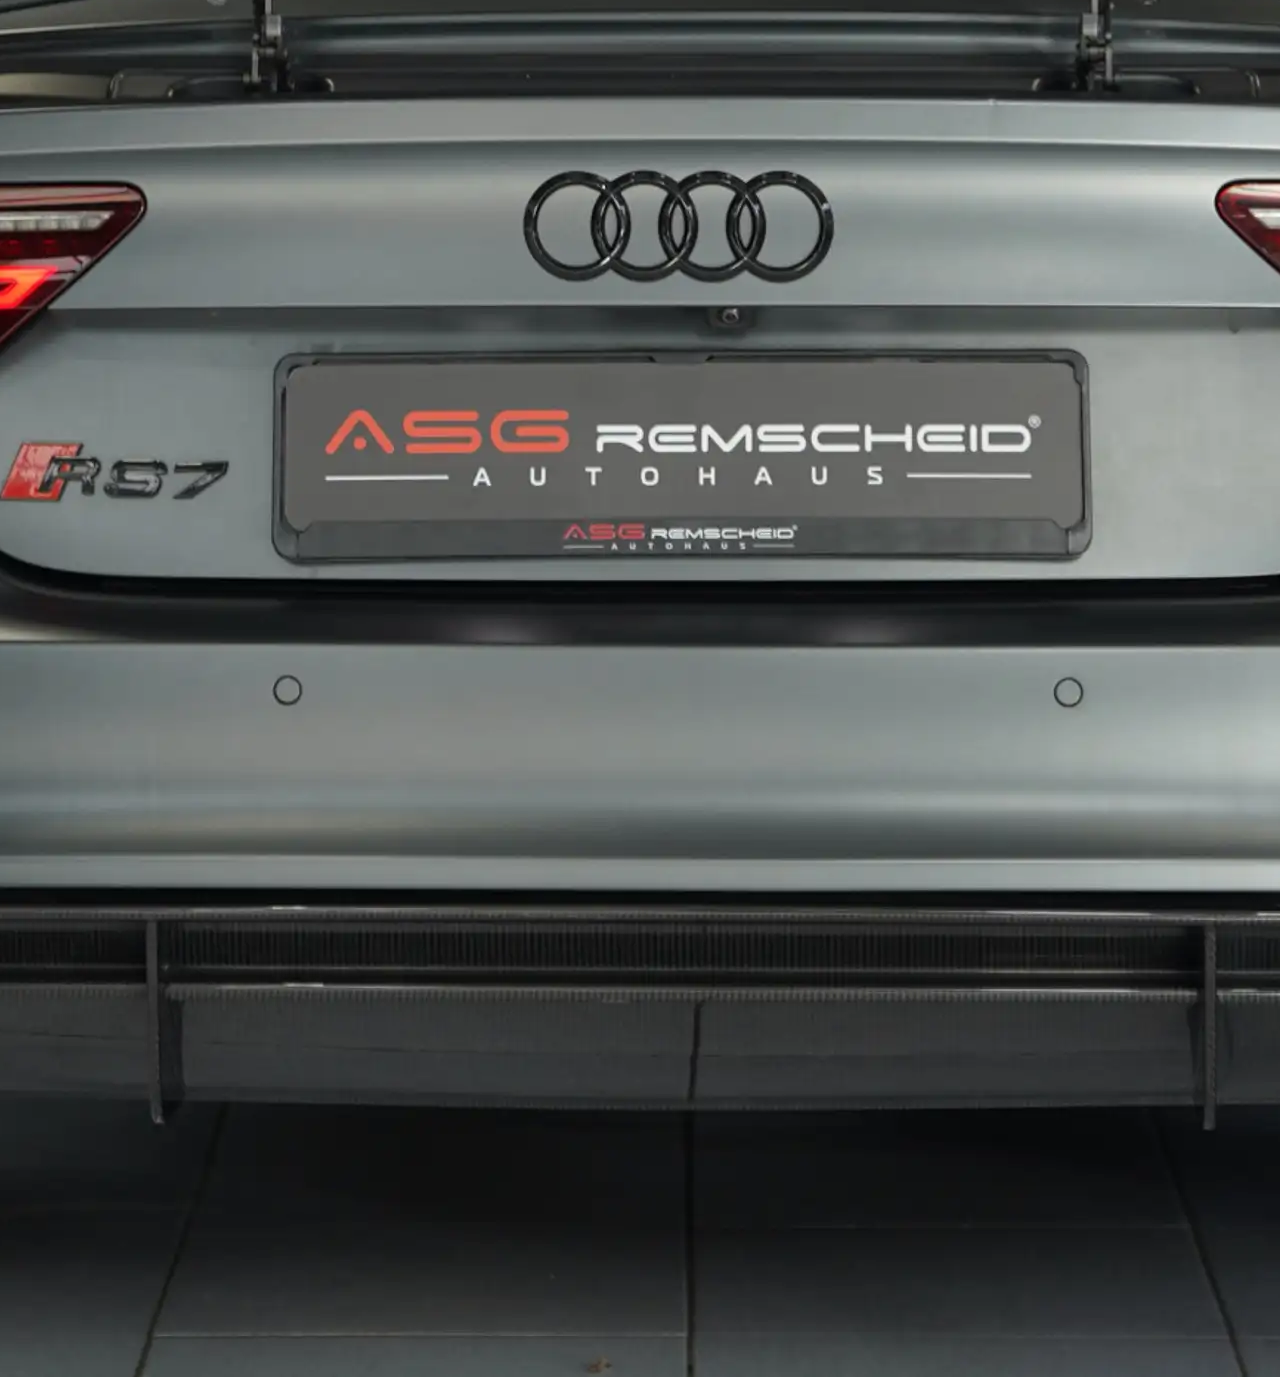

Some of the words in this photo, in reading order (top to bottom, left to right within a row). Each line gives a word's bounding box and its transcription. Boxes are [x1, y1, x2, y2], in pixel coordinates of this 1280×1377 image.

[324, 409, 570, 455] ASG
[38, 456, 230, 499] RS7
[472, 466, 885, 487] AUTOHAUS
[562, 523, 646, 541] ASG
[610, 542, 747, 551] AUTOHAUS
